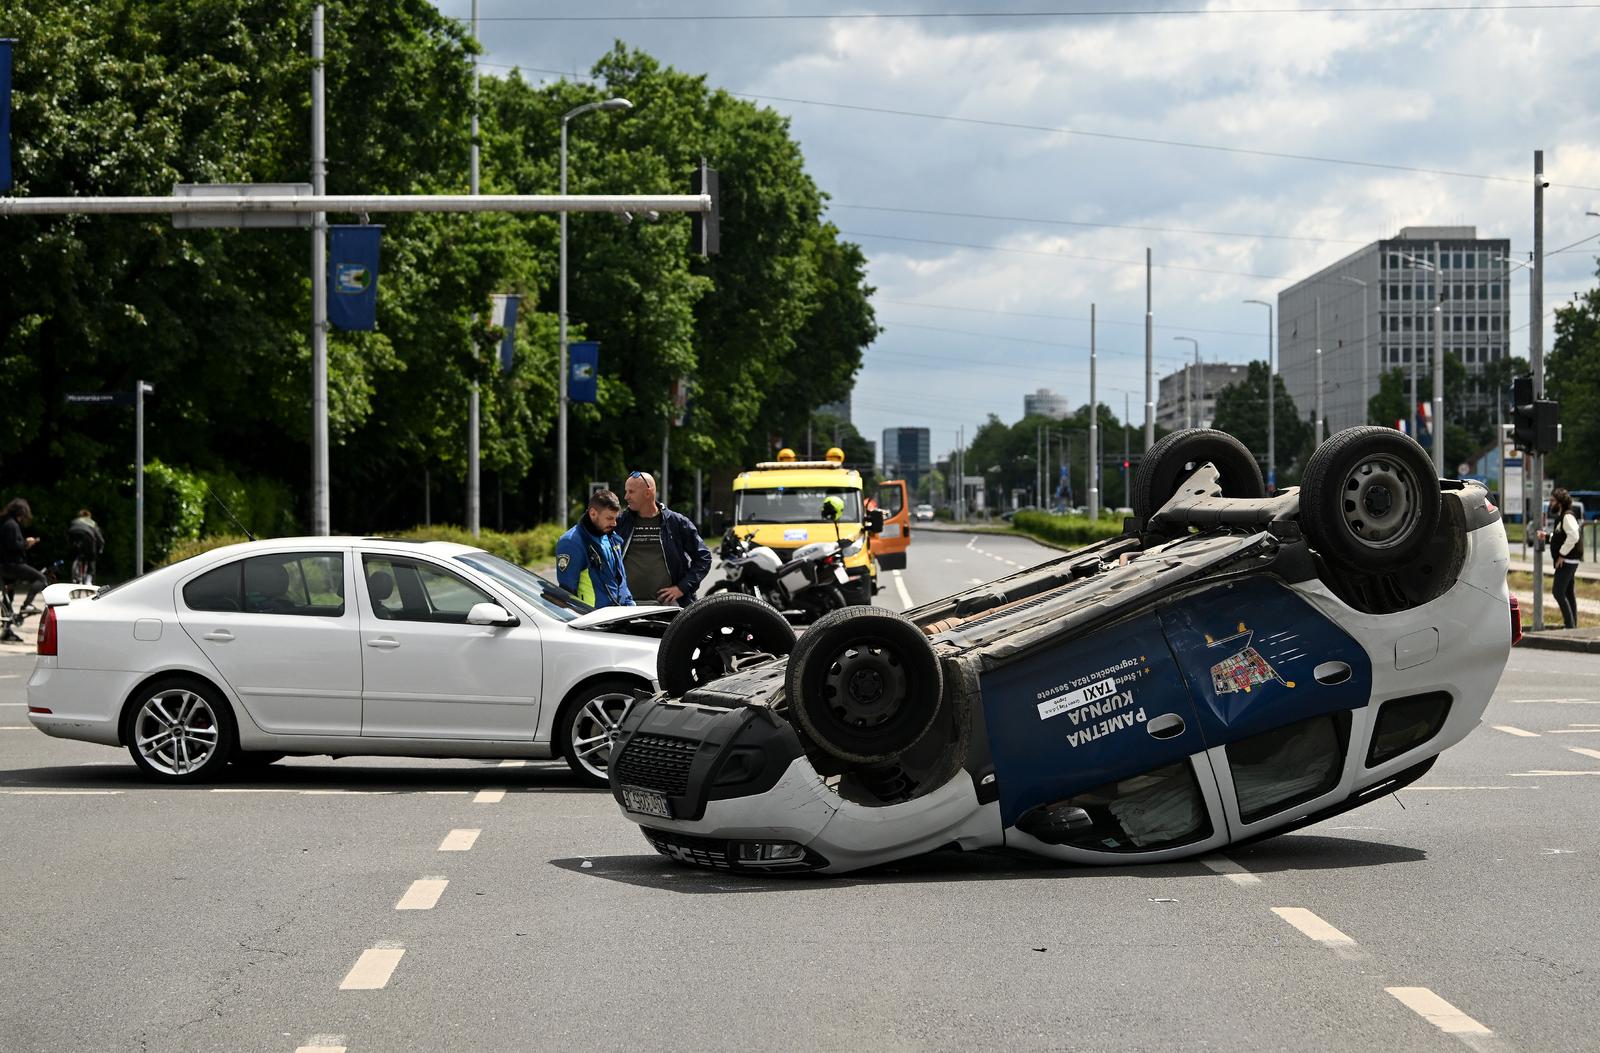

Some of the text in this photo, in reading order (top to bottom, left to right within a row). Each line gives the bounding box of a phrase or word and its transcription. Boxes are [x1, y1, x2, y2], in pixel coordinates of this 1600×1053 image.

[1090, 658, 1138, 680] Zagrebačka
[1115, 672, 1137, 685] Štefa
[1083, 681, 1114, 702] TAXI
[1067, 690, 1134, 725] KUPNJA
[1066, 707, 1147, 748] PAMETNA
